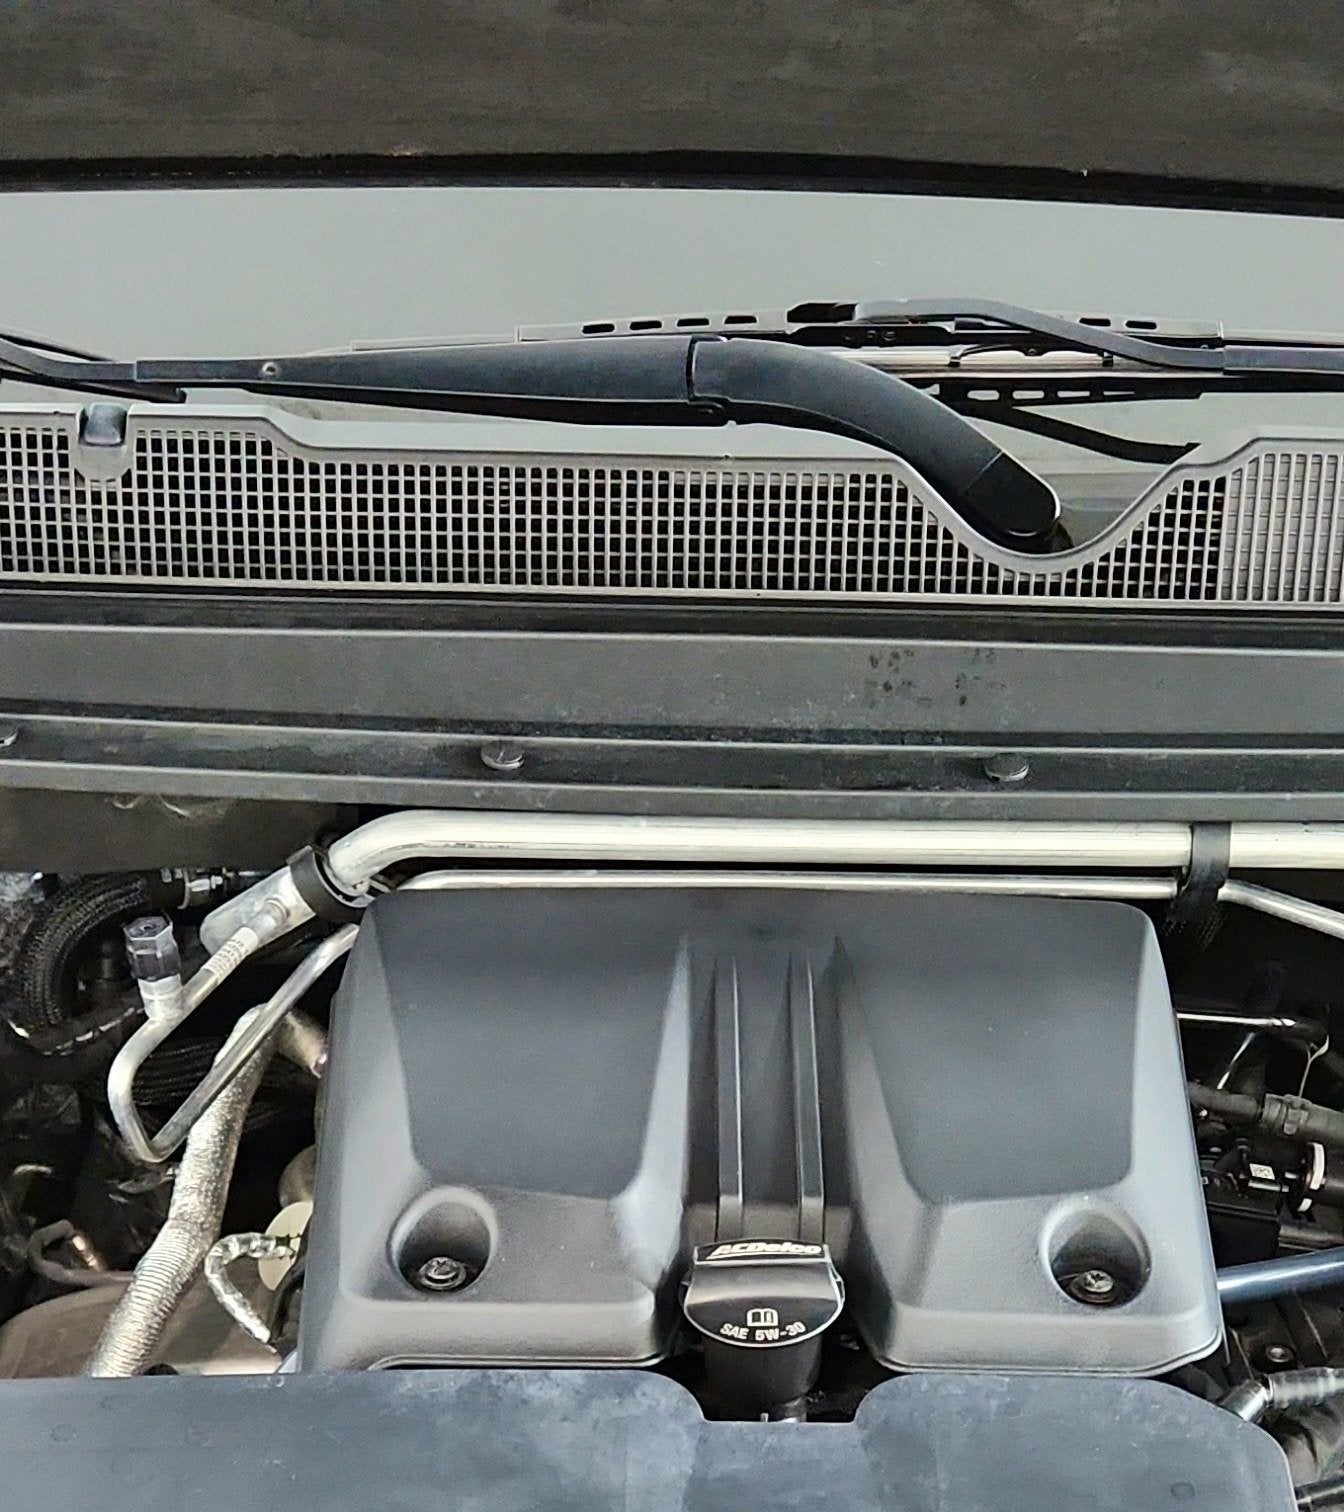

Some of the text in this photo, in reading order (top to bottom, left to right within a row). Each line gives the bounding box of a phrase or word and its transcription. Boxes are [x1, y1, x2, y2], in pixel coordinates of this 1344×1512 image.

[711, 1242, 822, 1256] ACDelco
[720, 1321, 806, 1341] SAE 5W-30
